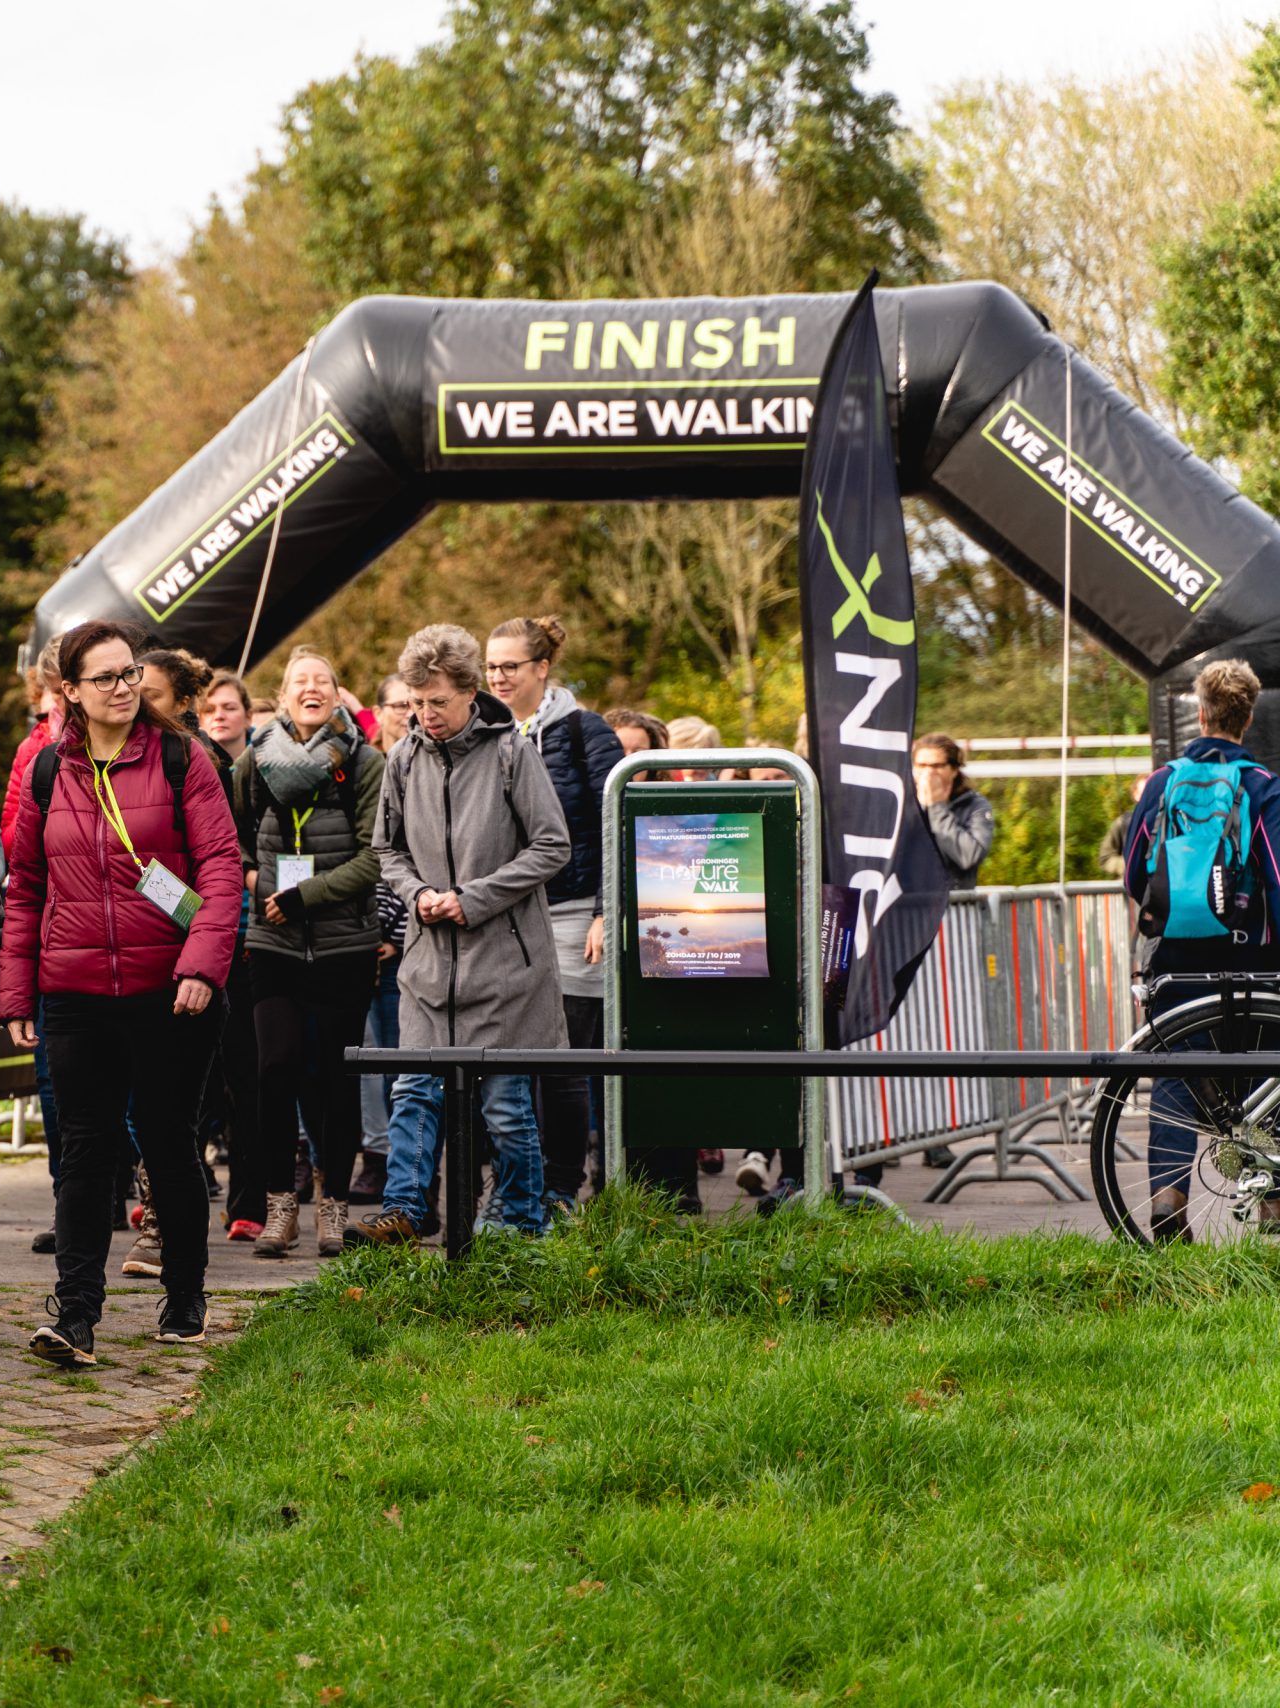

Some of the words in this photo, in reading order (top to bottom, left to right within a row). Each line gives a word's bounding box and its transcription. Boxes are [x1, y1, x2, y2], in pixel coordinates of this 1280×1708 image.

[524, 316, 797, 370] FINISH
[456, 401, 535, 438] WE
[543, 400, 638, 437] ARE
[646, 397, 816, 436] WALKIN
[147, 559, 196, 604] WE
[189, 518, 241, 574] ARE
[230, 428, 339, 527] WALKING
[1000, 415, 1049, 464] WE
[1039, 455, 1098, 506] ARE
[1091, 492, 1205, 596] WALKING
[660, 859, 739, 881] nature
[699, 881, 739, 892] WALK
